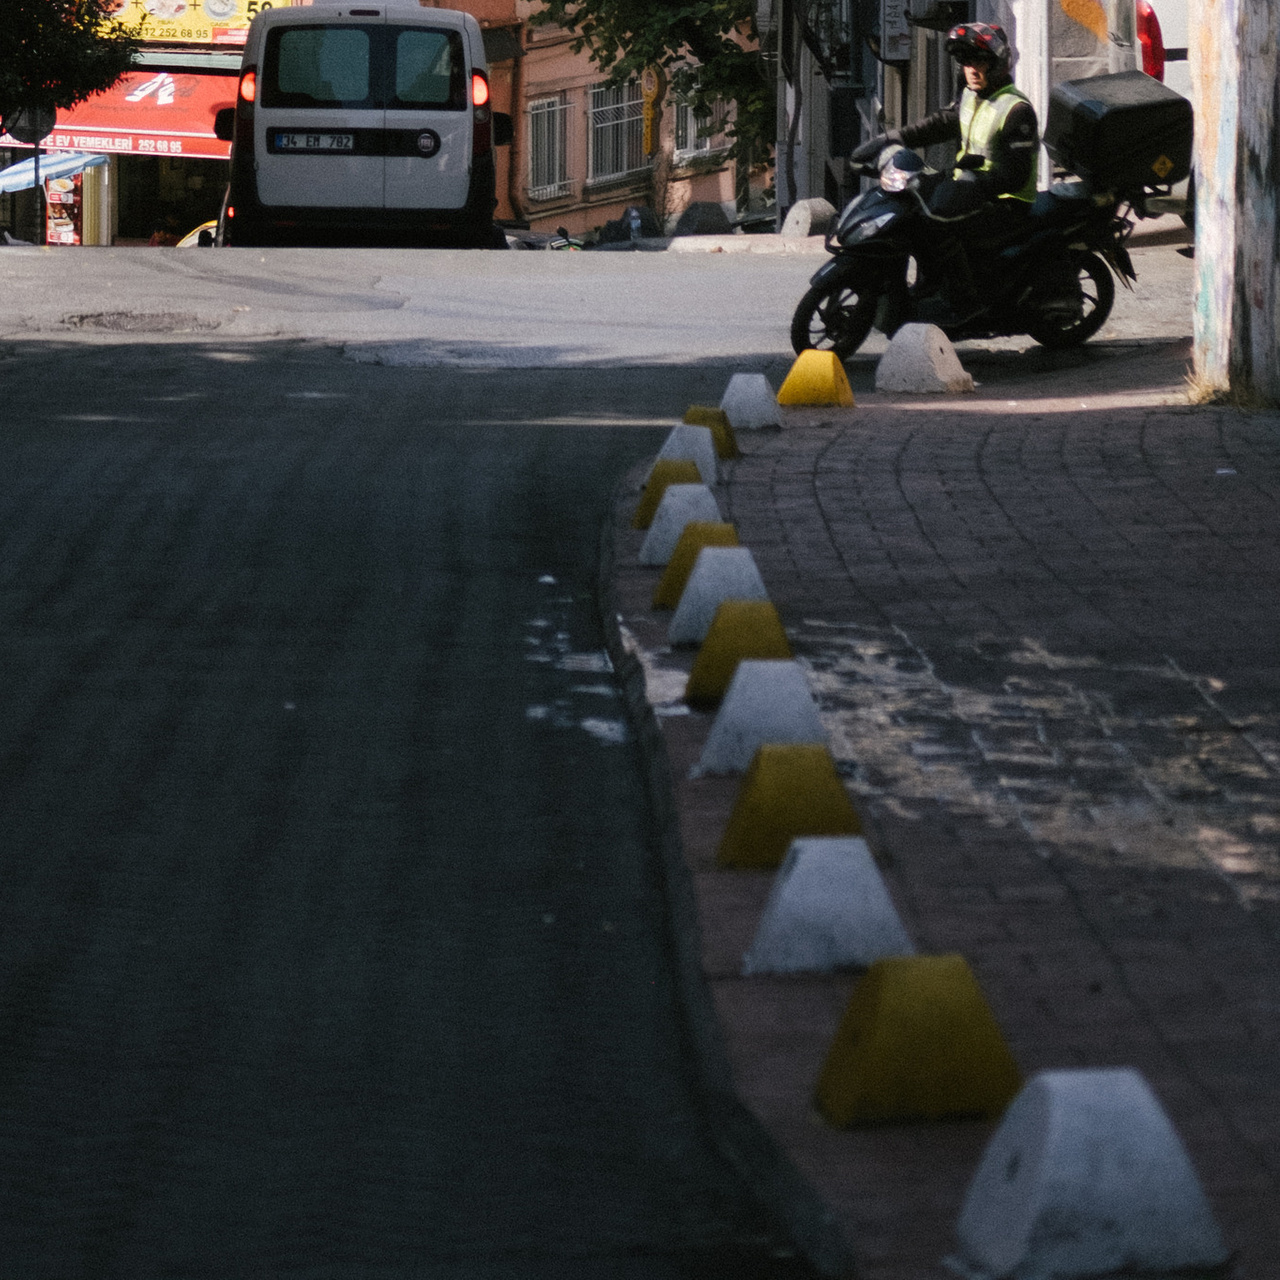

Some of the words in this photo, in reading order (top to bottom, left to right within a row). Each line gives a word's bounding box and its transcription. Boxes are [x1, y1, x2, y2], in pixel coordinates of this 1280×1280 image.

[159, 27, 178, 38] 252
[180, 28, 193, 39] 68
[195, 29, 209, 39] 95
[55, 135, 71, 148] EV
[72, 135, 133, 151] YEMEKLERİ
[283, 135, 298, 147] 34
